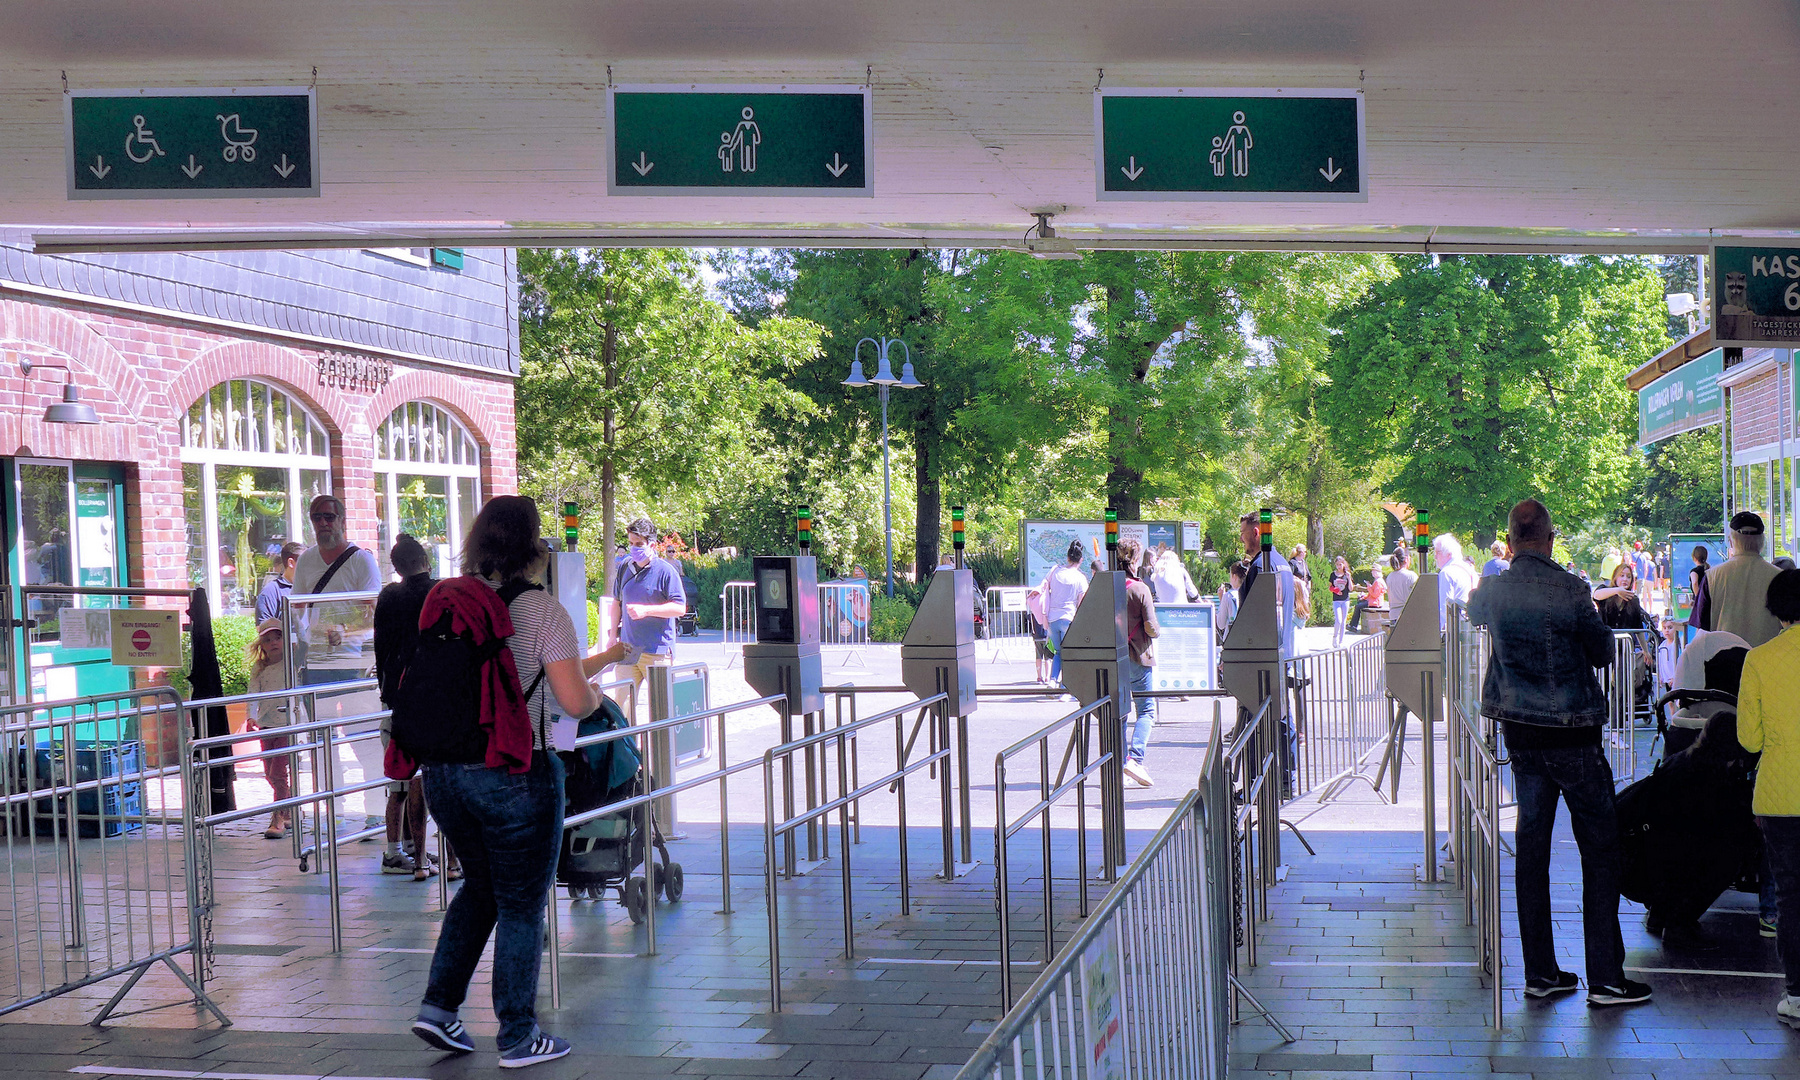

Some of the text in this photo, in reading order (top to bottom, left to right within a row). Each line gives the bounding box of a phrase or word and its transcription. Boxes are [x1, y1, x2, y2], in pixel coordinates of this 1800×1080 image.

[1752, 255, 1800, 279] KAS
[1753, 321, 1800, 329] TAGESTICK
[1761, 329, 1800, 337] JAHRESK
